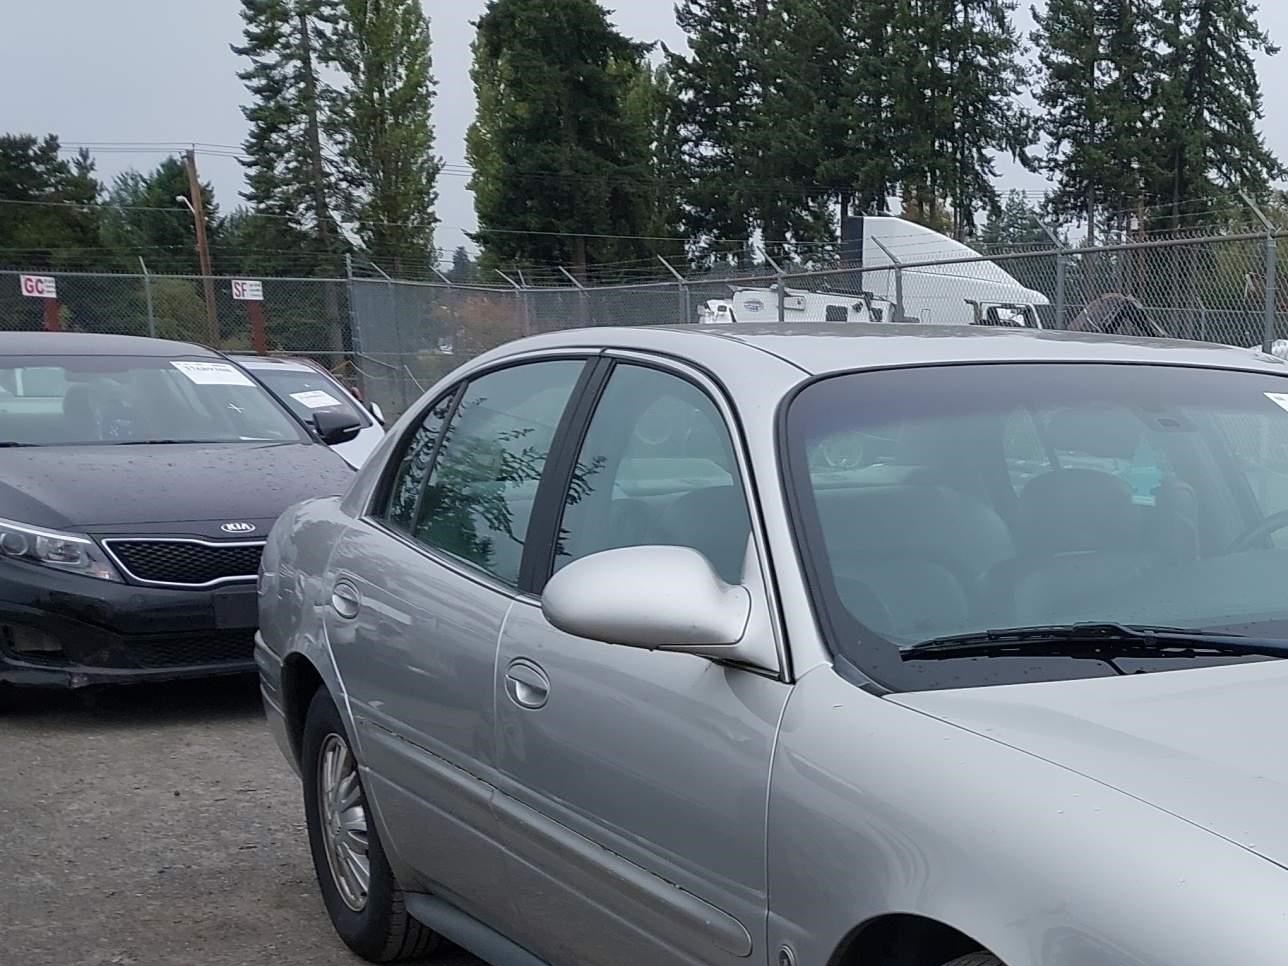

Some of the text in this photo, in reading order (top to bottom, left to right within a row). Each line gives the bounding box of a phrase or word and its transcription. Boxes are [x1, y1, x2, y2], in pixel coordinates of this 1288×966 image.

[24, 277, 44, 294] GC
[233, 281, 248, 298] SF
[223, 522, 252, 531] KIA
